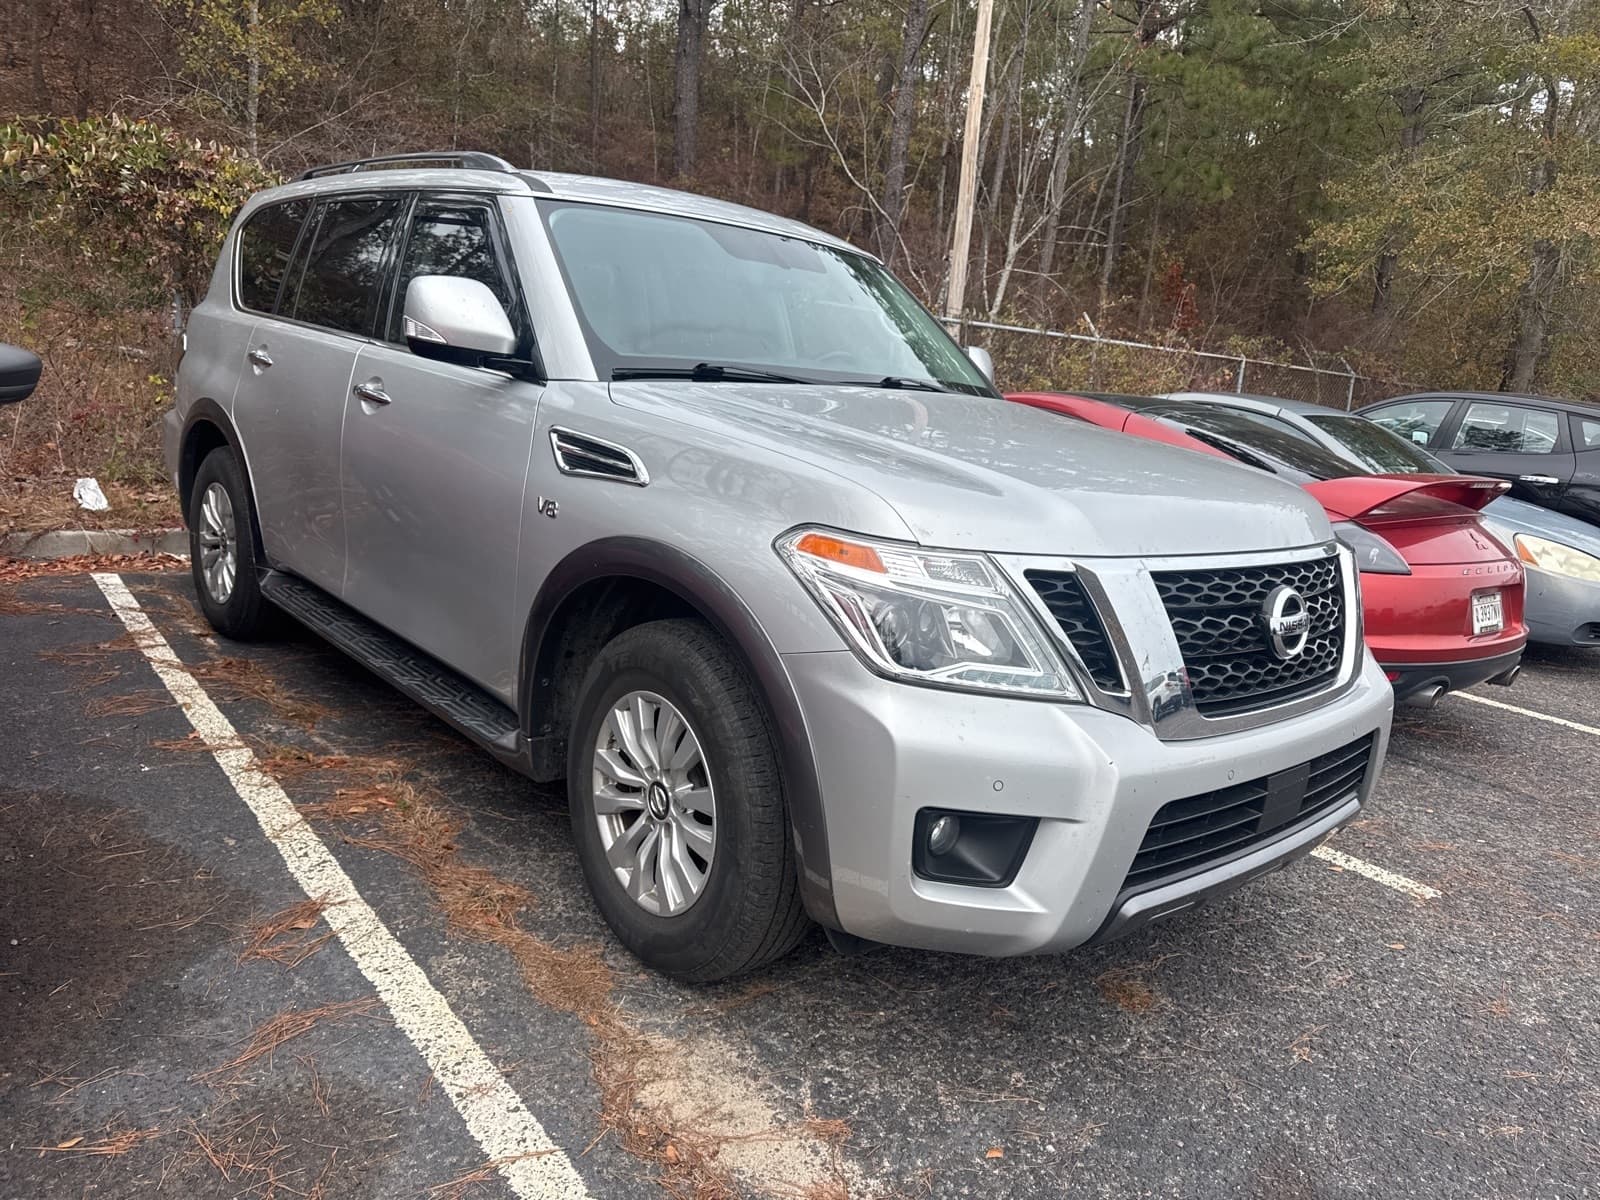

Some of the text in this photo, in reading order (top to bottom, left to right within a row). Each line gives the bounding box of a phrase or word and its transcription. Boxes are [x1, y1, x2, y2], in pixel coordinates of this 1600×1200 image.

[537, 496, 558, 518] V8
[1463, 564, 1516, 575] ECLIPS
[1280, 615, 1309, 632] NISSA
